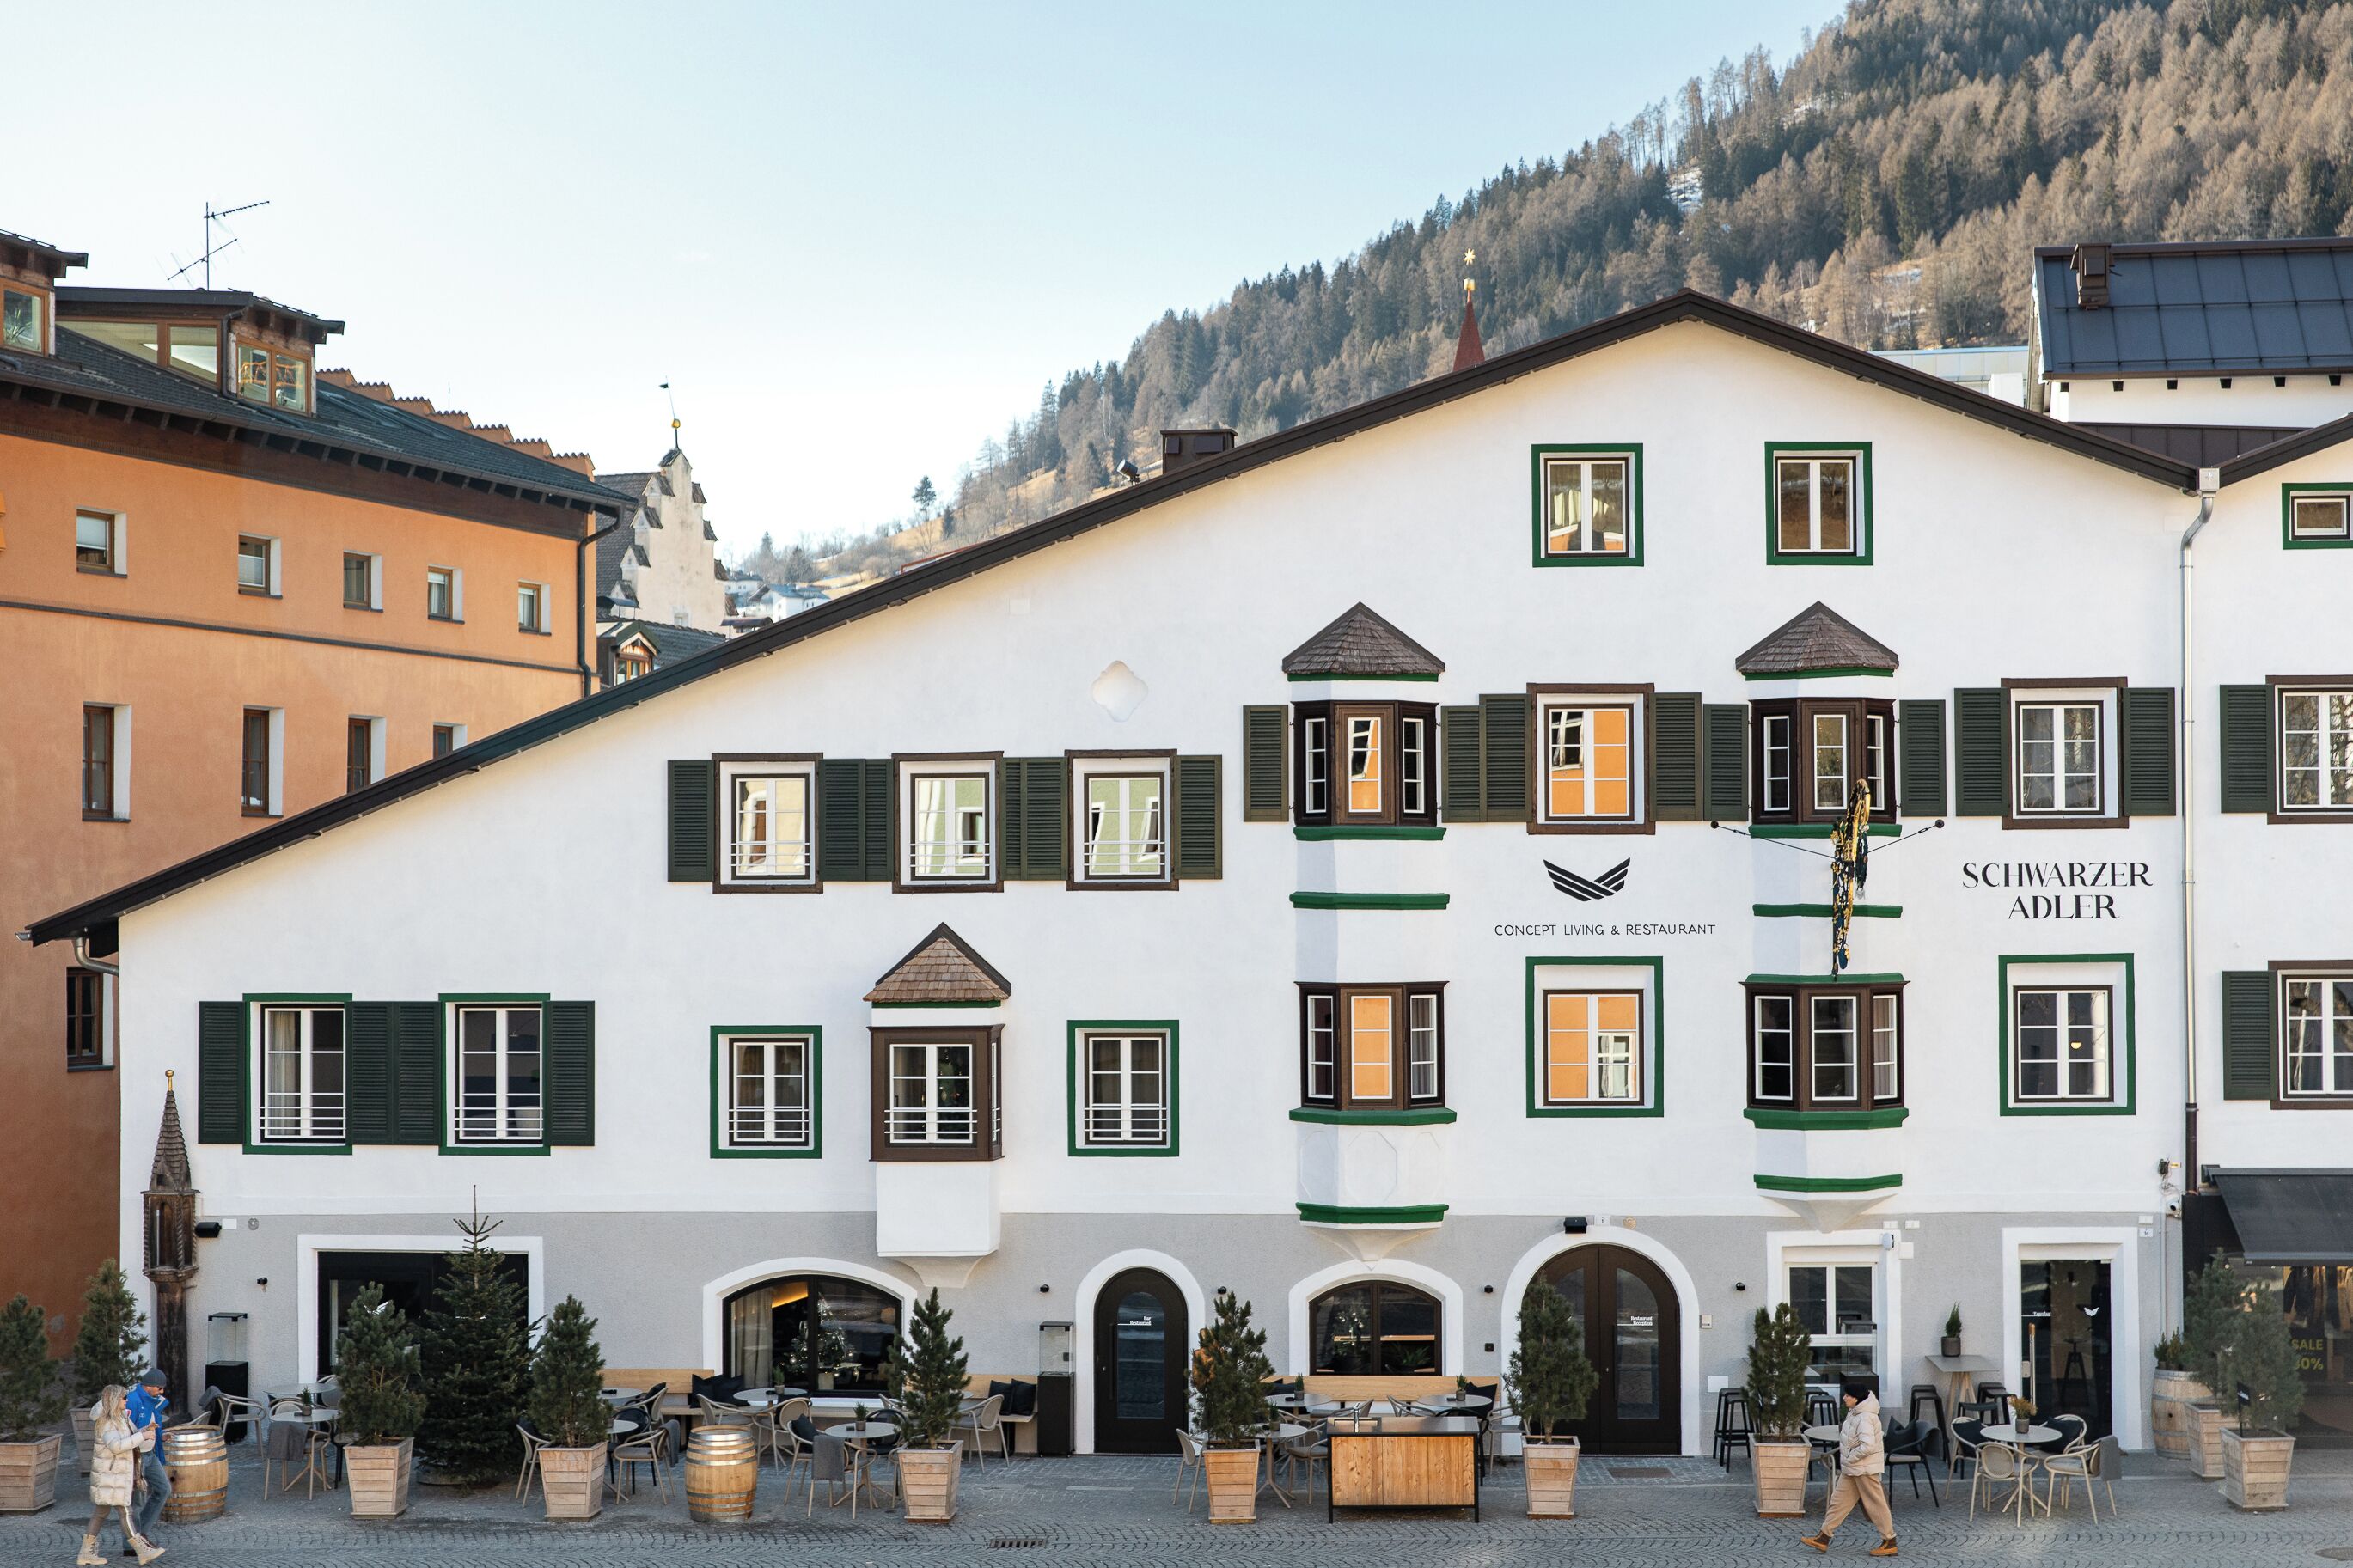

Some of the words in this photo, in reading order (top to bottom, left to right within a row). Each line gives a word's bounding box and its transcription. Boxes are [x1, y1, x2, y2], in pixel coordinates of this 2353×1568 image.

[1962, 862, 2154, 888] SCHWARZER
[2008, 894, 2120, 919] ADLER
[1494, 924, 1557, 936] CONCEPT
[1563, 924, 1604, 936] LIVING
[1610, 924, 1621, 936] &
[1626, 924, 1716, 936] RESTAURANT
[2291, 1339, 2324, 1351] SALE
